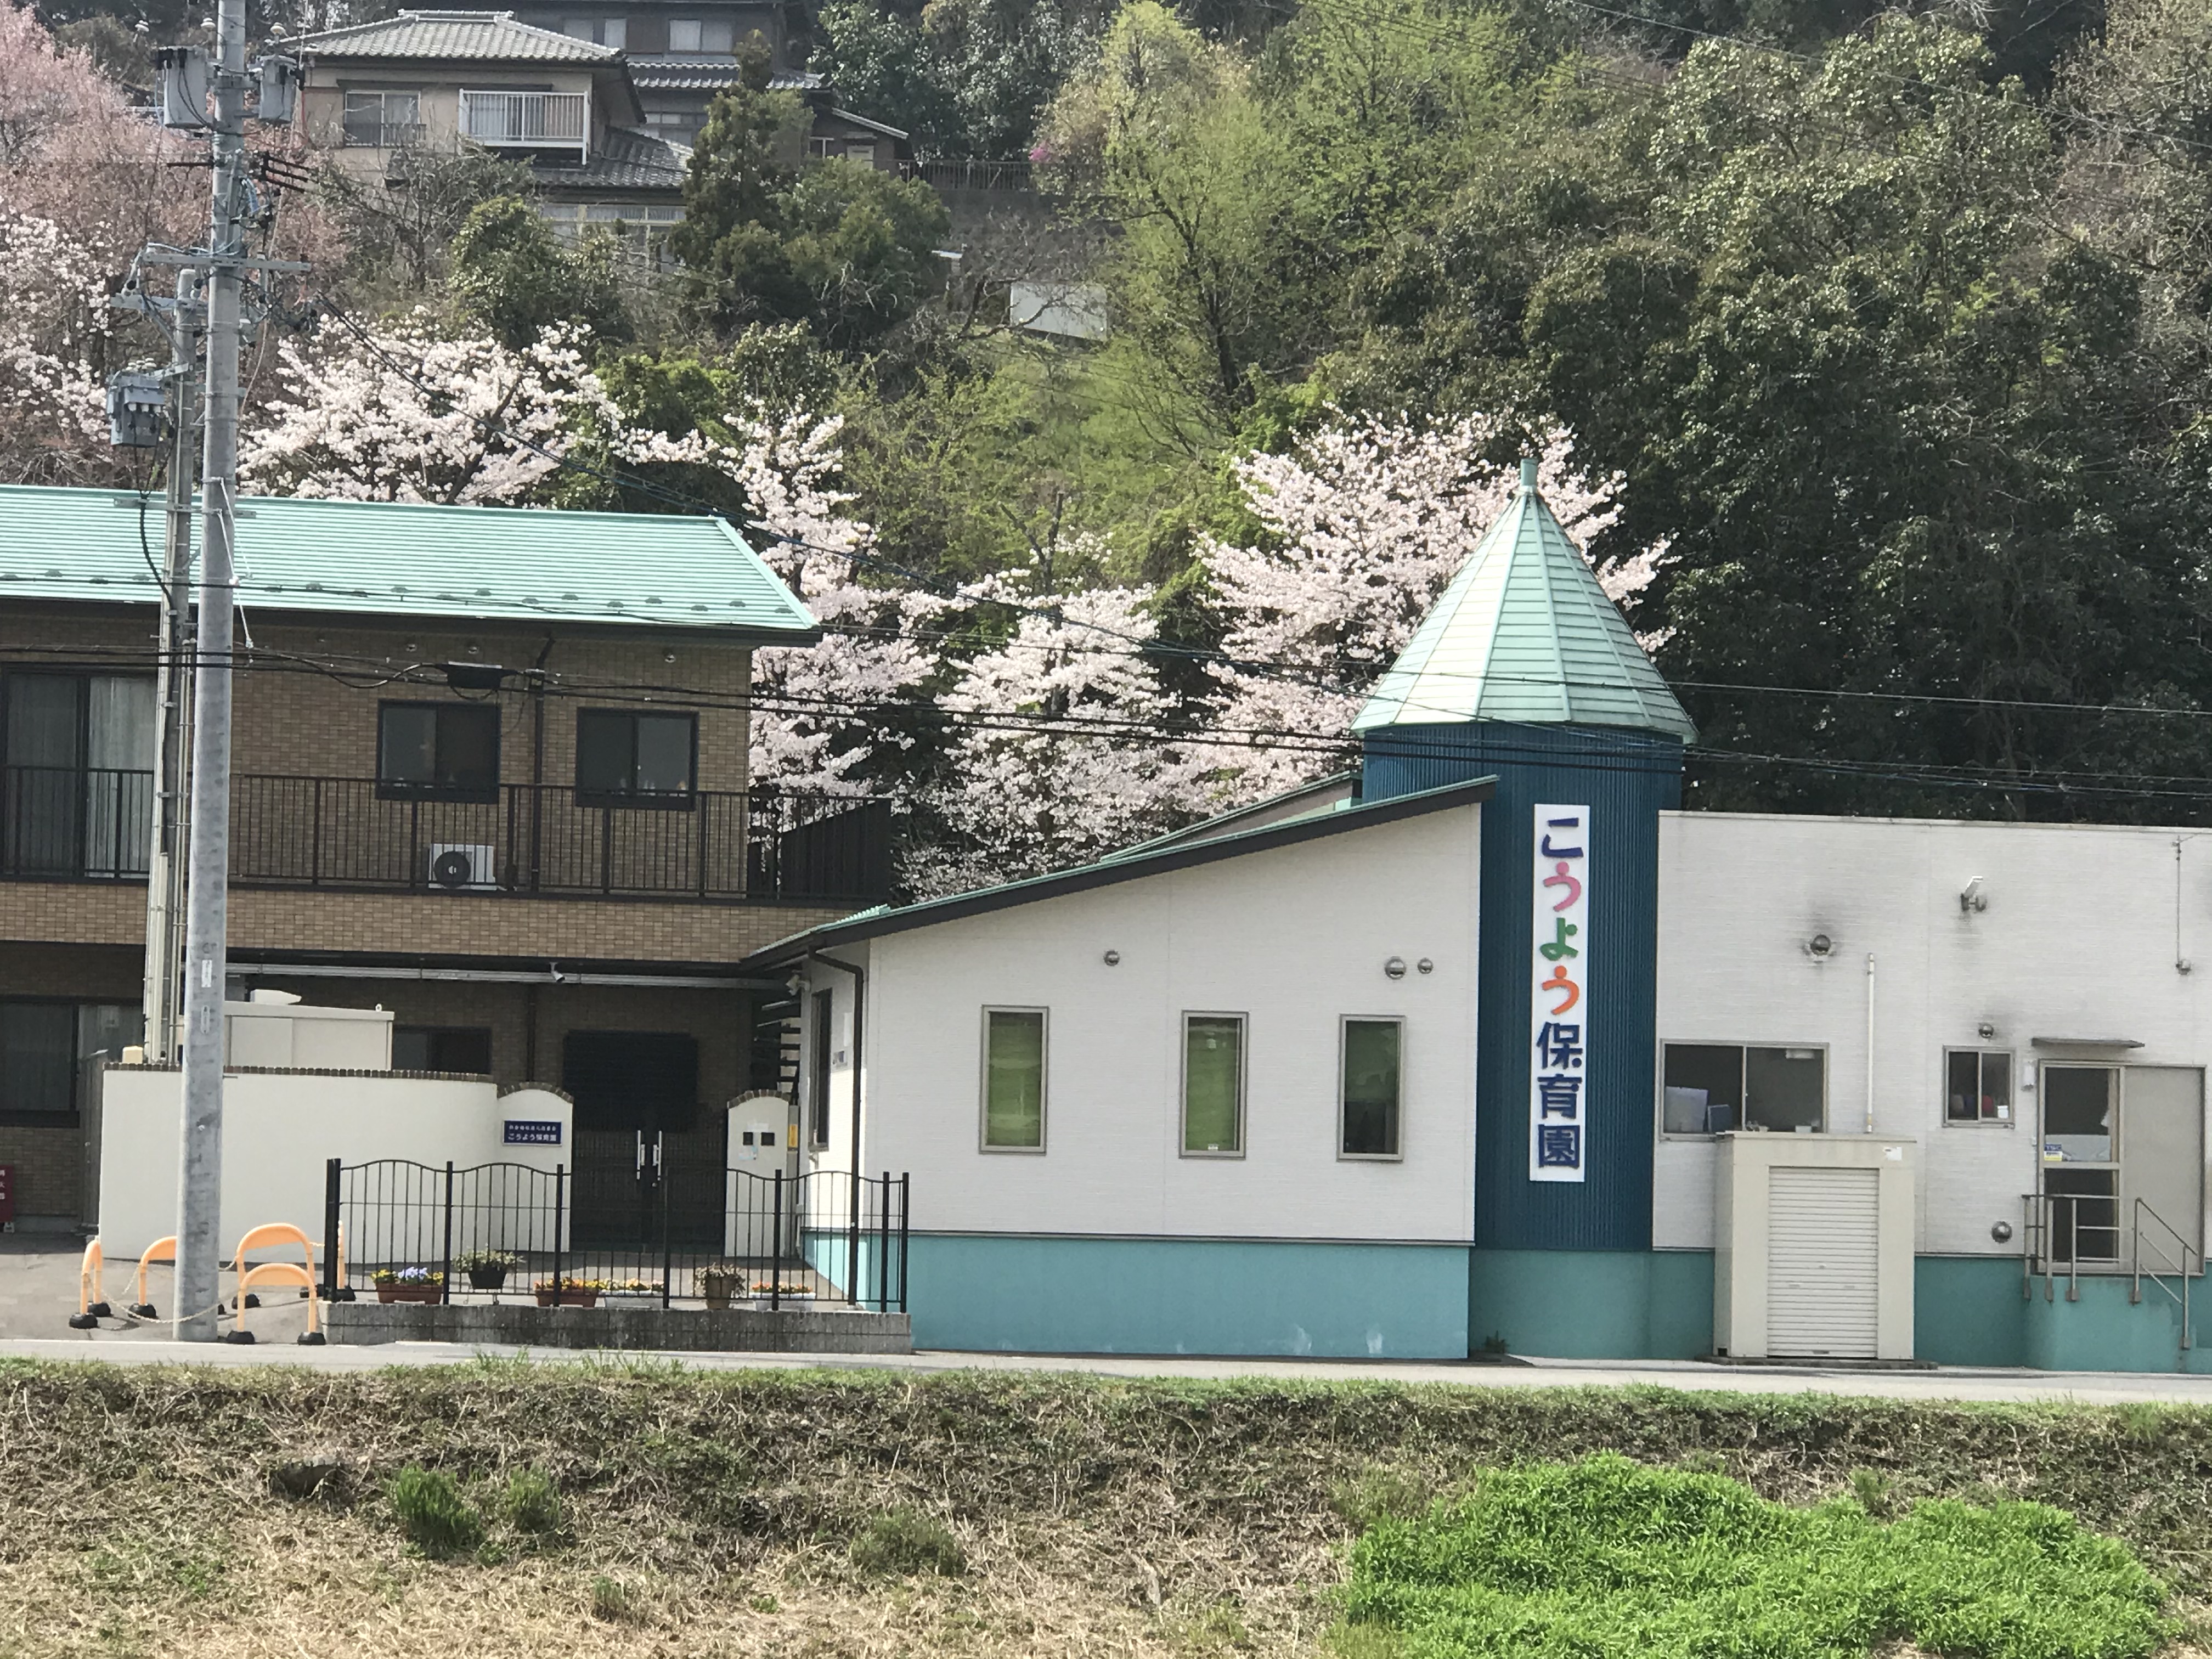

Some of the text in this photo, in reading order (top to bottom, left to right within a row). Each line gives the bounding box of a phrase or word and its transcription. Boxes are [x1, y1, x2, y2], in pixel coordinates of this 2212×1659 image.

[1537, 817, 1584, 1169] こうよう保育園
